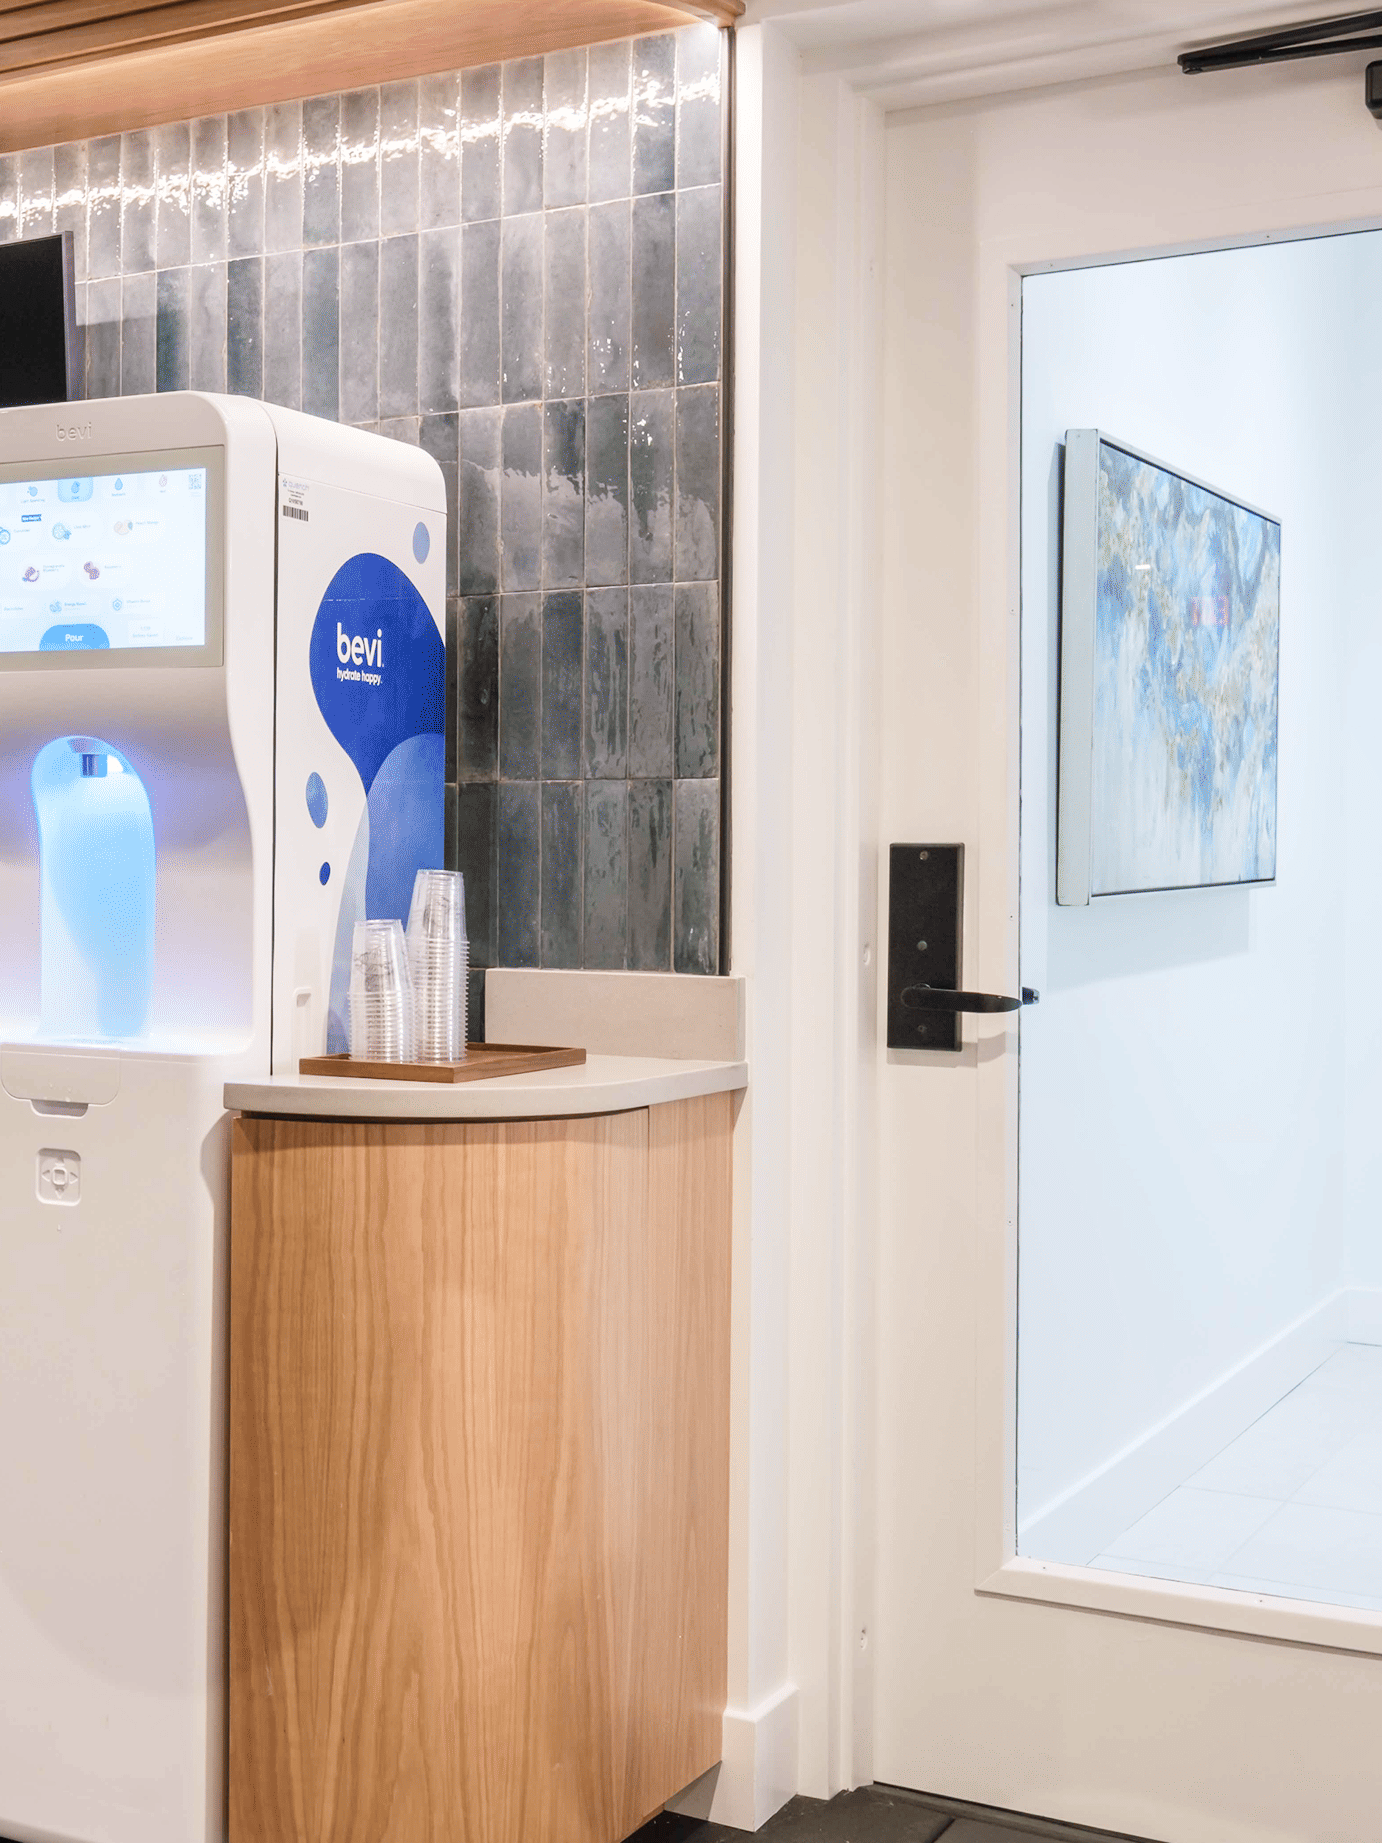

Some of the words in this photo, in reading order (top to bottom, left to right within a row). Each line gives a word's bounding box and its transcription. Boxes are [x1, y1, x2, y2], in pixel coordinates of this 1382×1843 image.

[55, 421, 92, 442] bevi
[64, 633, 84, 642] Pour
[336, 666, 361, 682] hydrate
